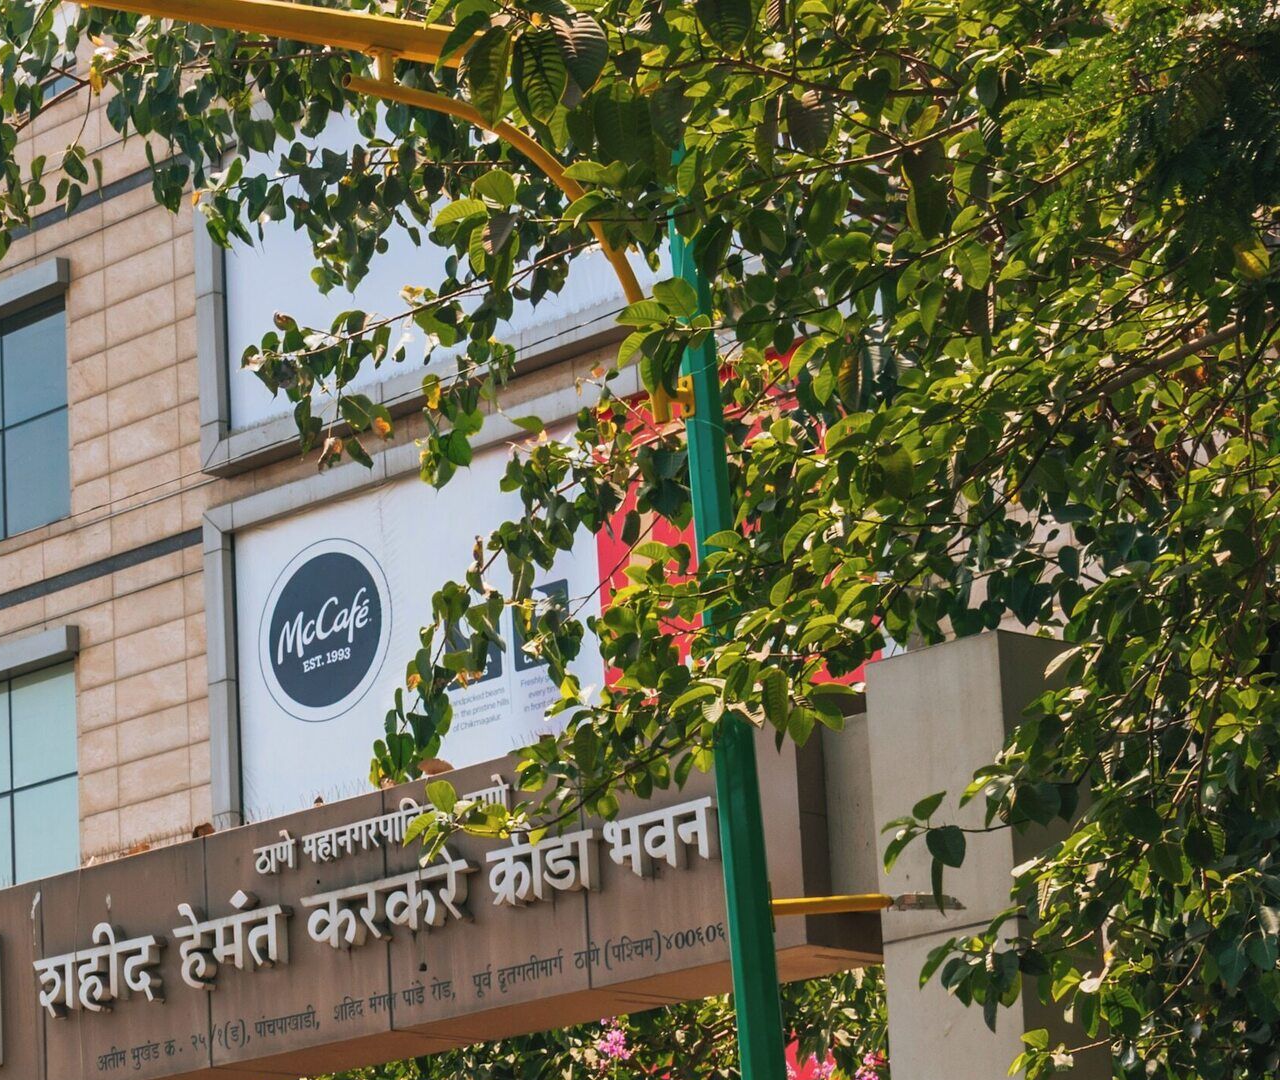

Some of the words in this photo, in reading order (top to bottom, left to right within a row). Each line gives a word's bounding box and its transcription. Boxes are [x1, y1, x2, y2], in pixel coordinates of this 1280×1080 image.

[277, 587, 371, 665] McCafé
[303, 655, 324, 673] EST.
[326, 647, 351, 664] 1993
[253, 830, 296, 873] ठाणे
[32, 922, 156, 1018] शहीद
[172, 889, 283, 990] हेमंत
[300, 846, 469, 948] करकरे
[603, 796, 712, 877] भवन
[472, 963, 492, 998] पूर्व
[574, 941, 600, 969] ठाणे
